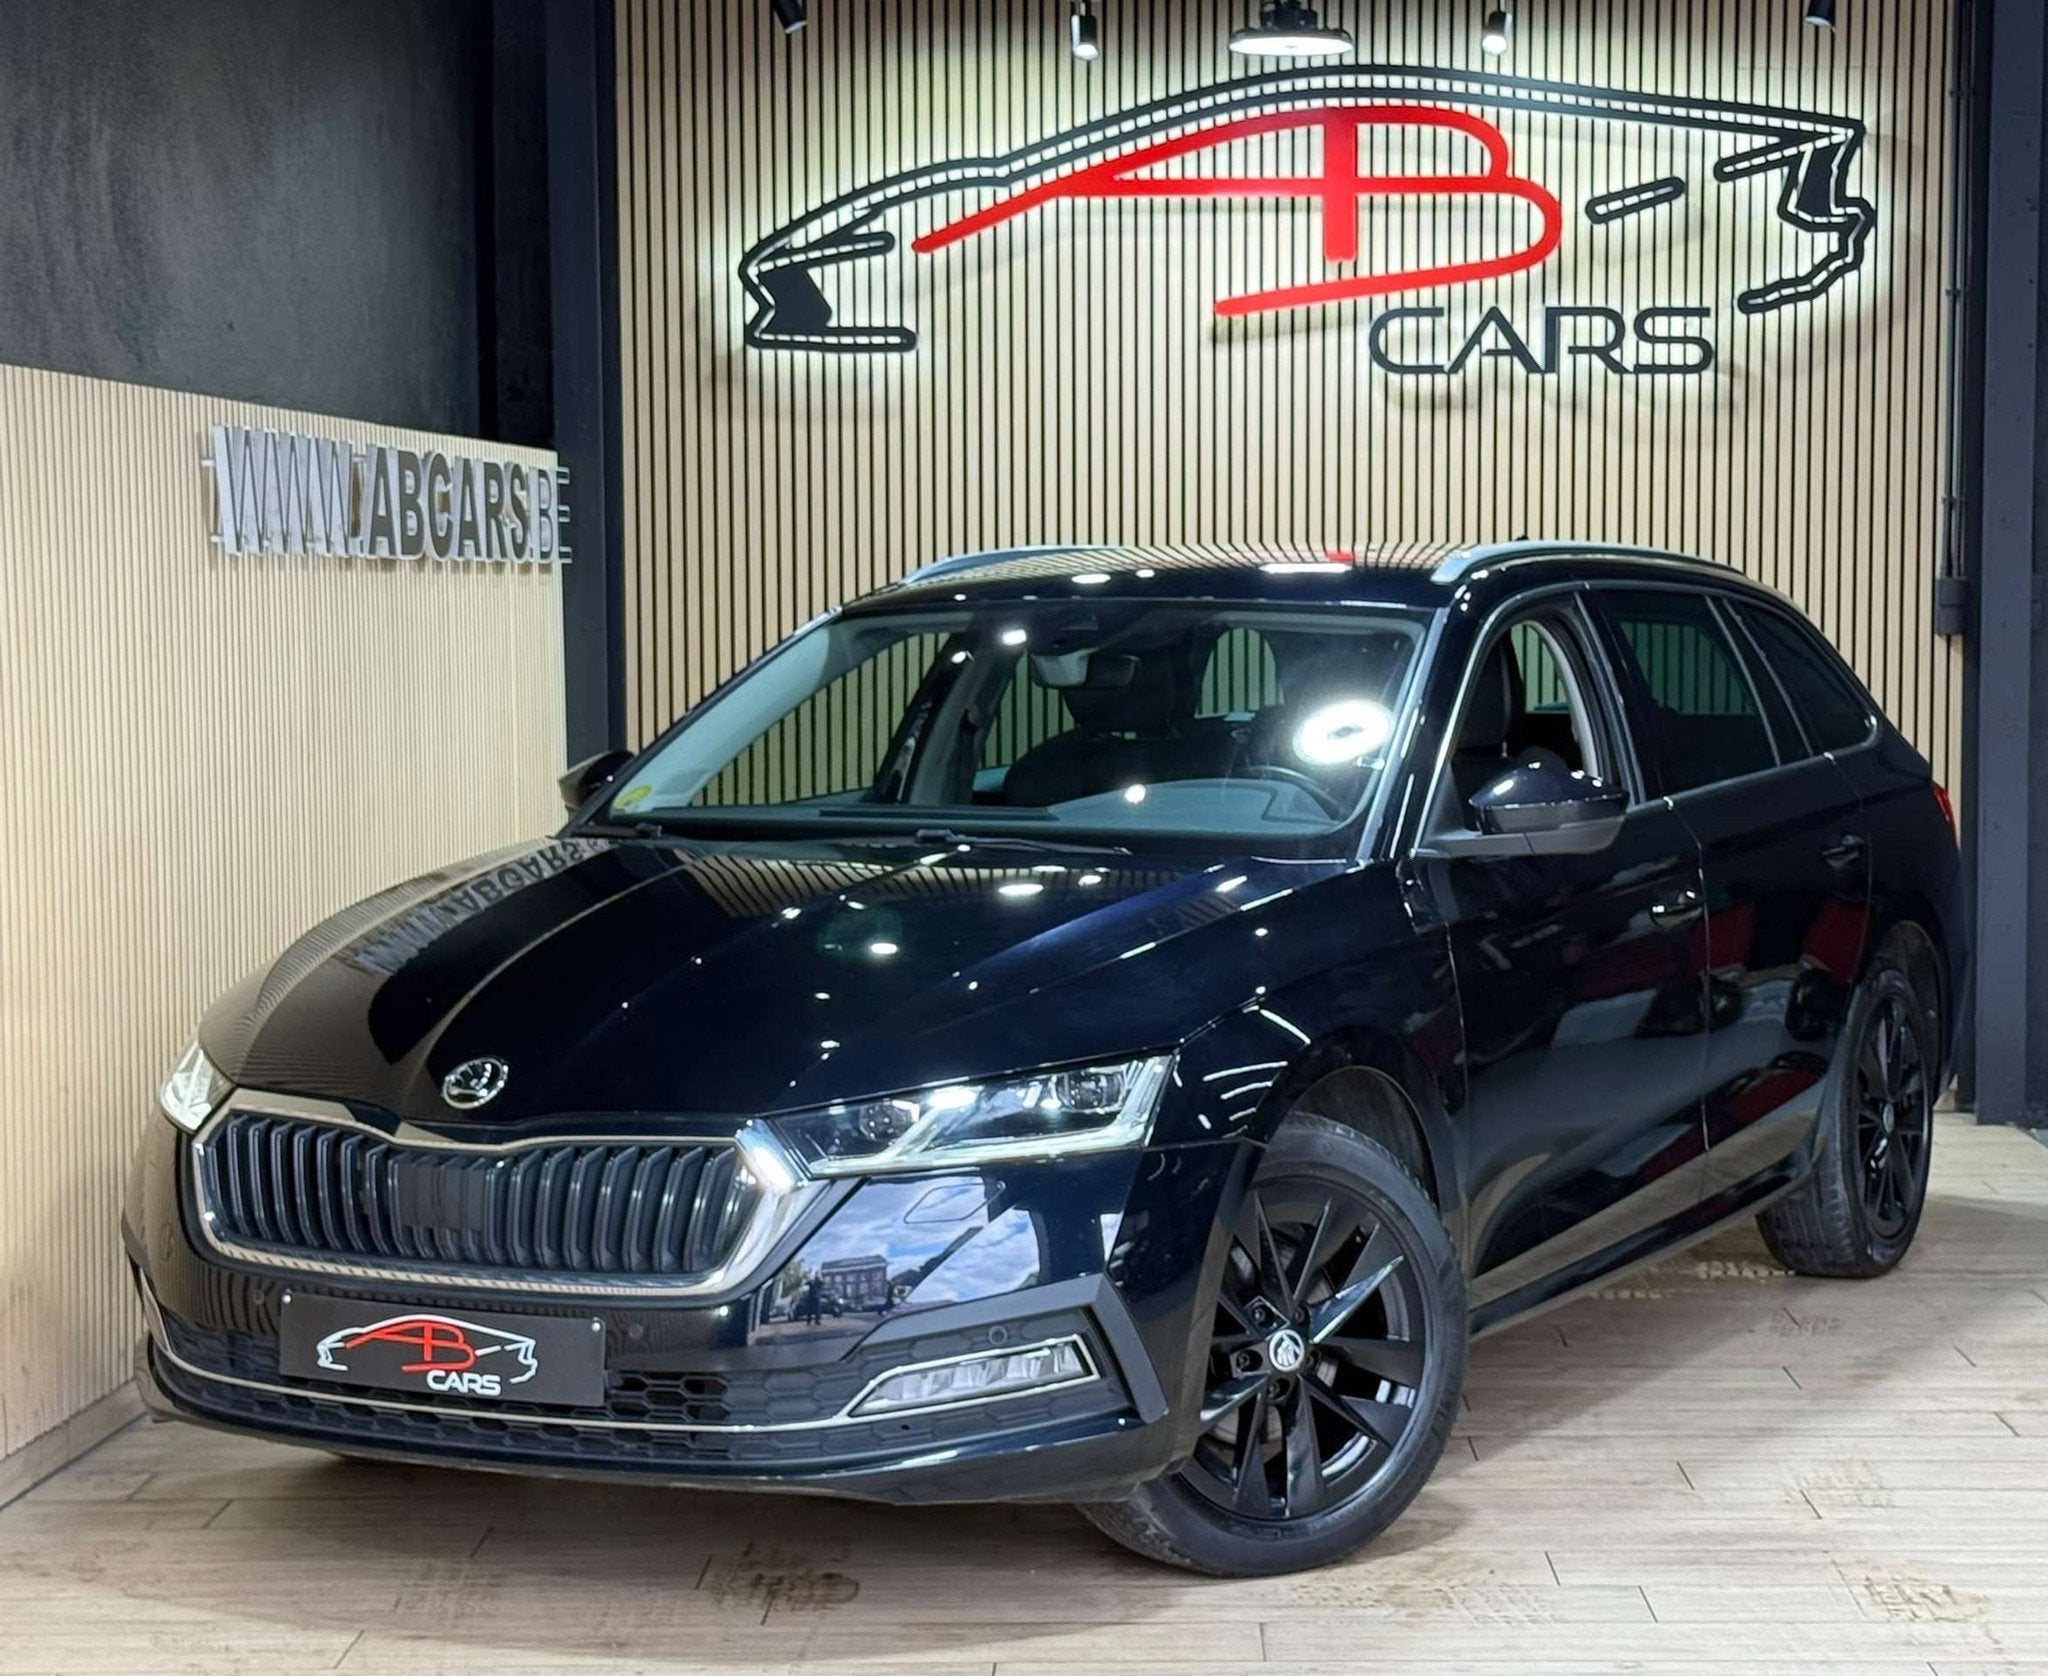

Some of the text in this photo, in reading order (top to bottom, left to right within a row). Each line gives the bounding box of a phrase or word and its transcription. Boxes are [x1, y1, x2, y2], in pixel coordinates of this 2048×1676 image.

[1369, 306, 1714, 375] CARS
[209, 424, 572, 564] WWW.ABCARS.BE
[427, 1369, 501, 1396] CARS
